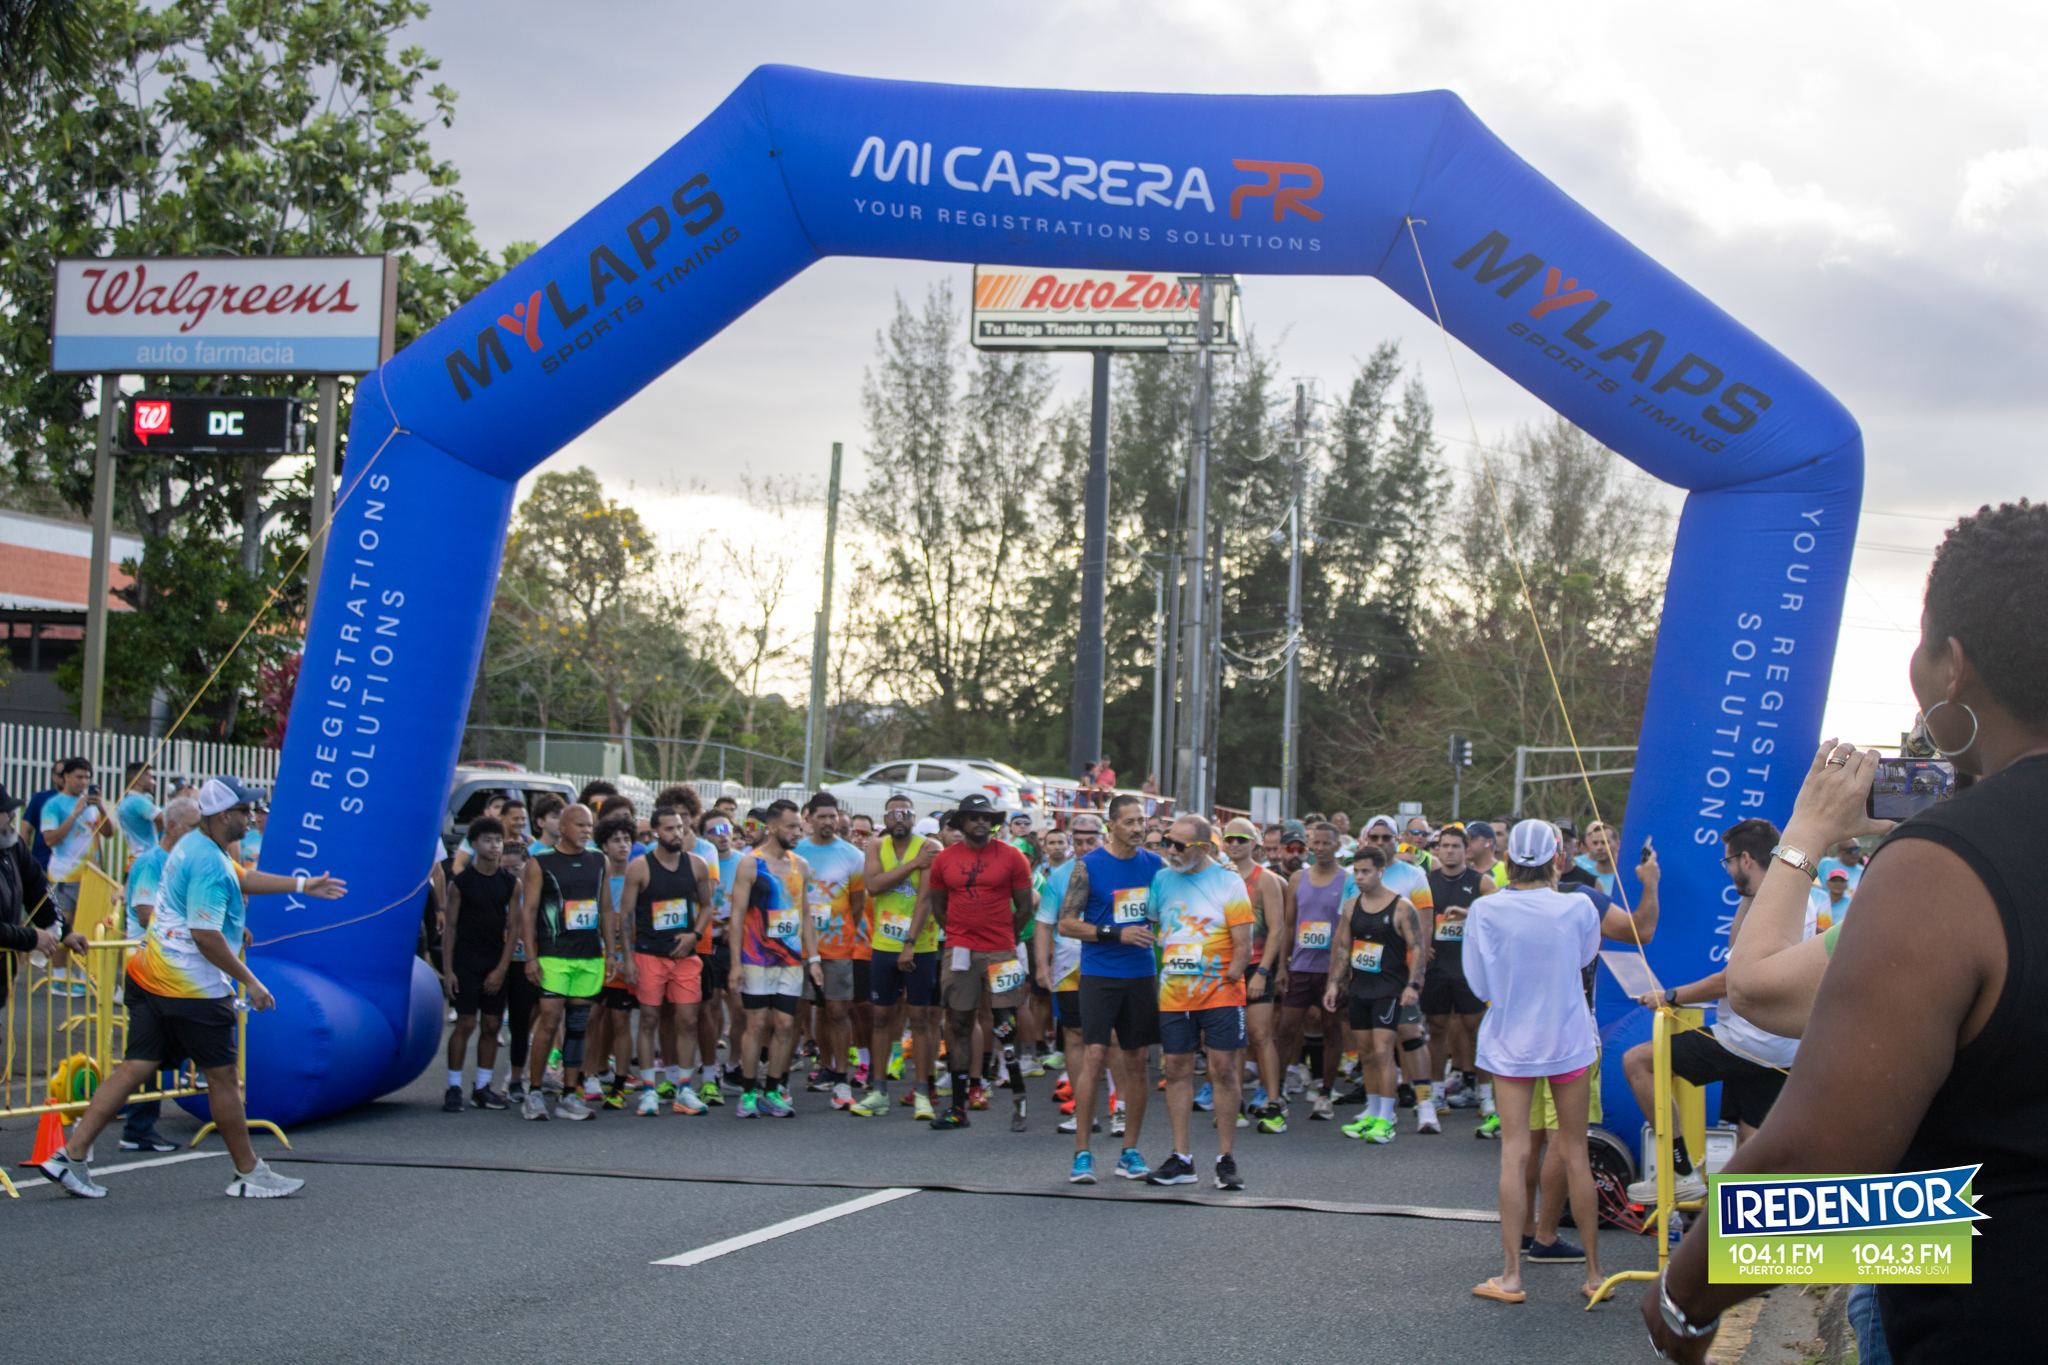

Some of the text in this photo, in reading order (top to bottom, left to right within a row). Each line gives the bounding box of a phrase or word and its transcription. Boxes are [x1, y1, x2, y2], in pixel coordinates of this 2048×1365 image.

[851, 136, 1325, 223] MI CARRERA PR
[854, 198, 1322, 252] YOUR REGISTRATIONS SOLUTIONS
[82, 264, 360, 333] Walgreens
[445, 172, 725, 402] MYLAPS
[541, 225, 741, 374] SPORTS TIMING
[983, 322, 1002, 336] Tu
[1005, 322, 1042, 338] Mega
[1045, 322, 1092, 336] Tienda
[1095, 322, 1113, 336] de
[1115, 322, 1162, 336] Piezas
[1452, 229, 1773, 435] MYLAPS
[136, 340, 295, 364] auto farmacia
[1506, 322, 1725, 453] SPORTS TIMING
[208, 411, 245, 436] DC
[1780, 508, 1824, 612] YOUR
[311, 473, 390, 790] REGISTRATIONS
[341, 589, 405, 814] SOLUTIONS
[1694, 612, 1762, 846] SOLUTIONS
[576, 913, 590, 926] 41
[663, 912, 679, 925] 70
[1121, 902, 1147, 918] 169
[777, 921, 792, 933] 66
[883, 923, 904, 937] 617
[1303, 933, 1326, 945] 500
[1440, 925, 1463, 937] 462
[1355, 953, 1377, 968] 495
[996, 972, 1021, 988] 570
